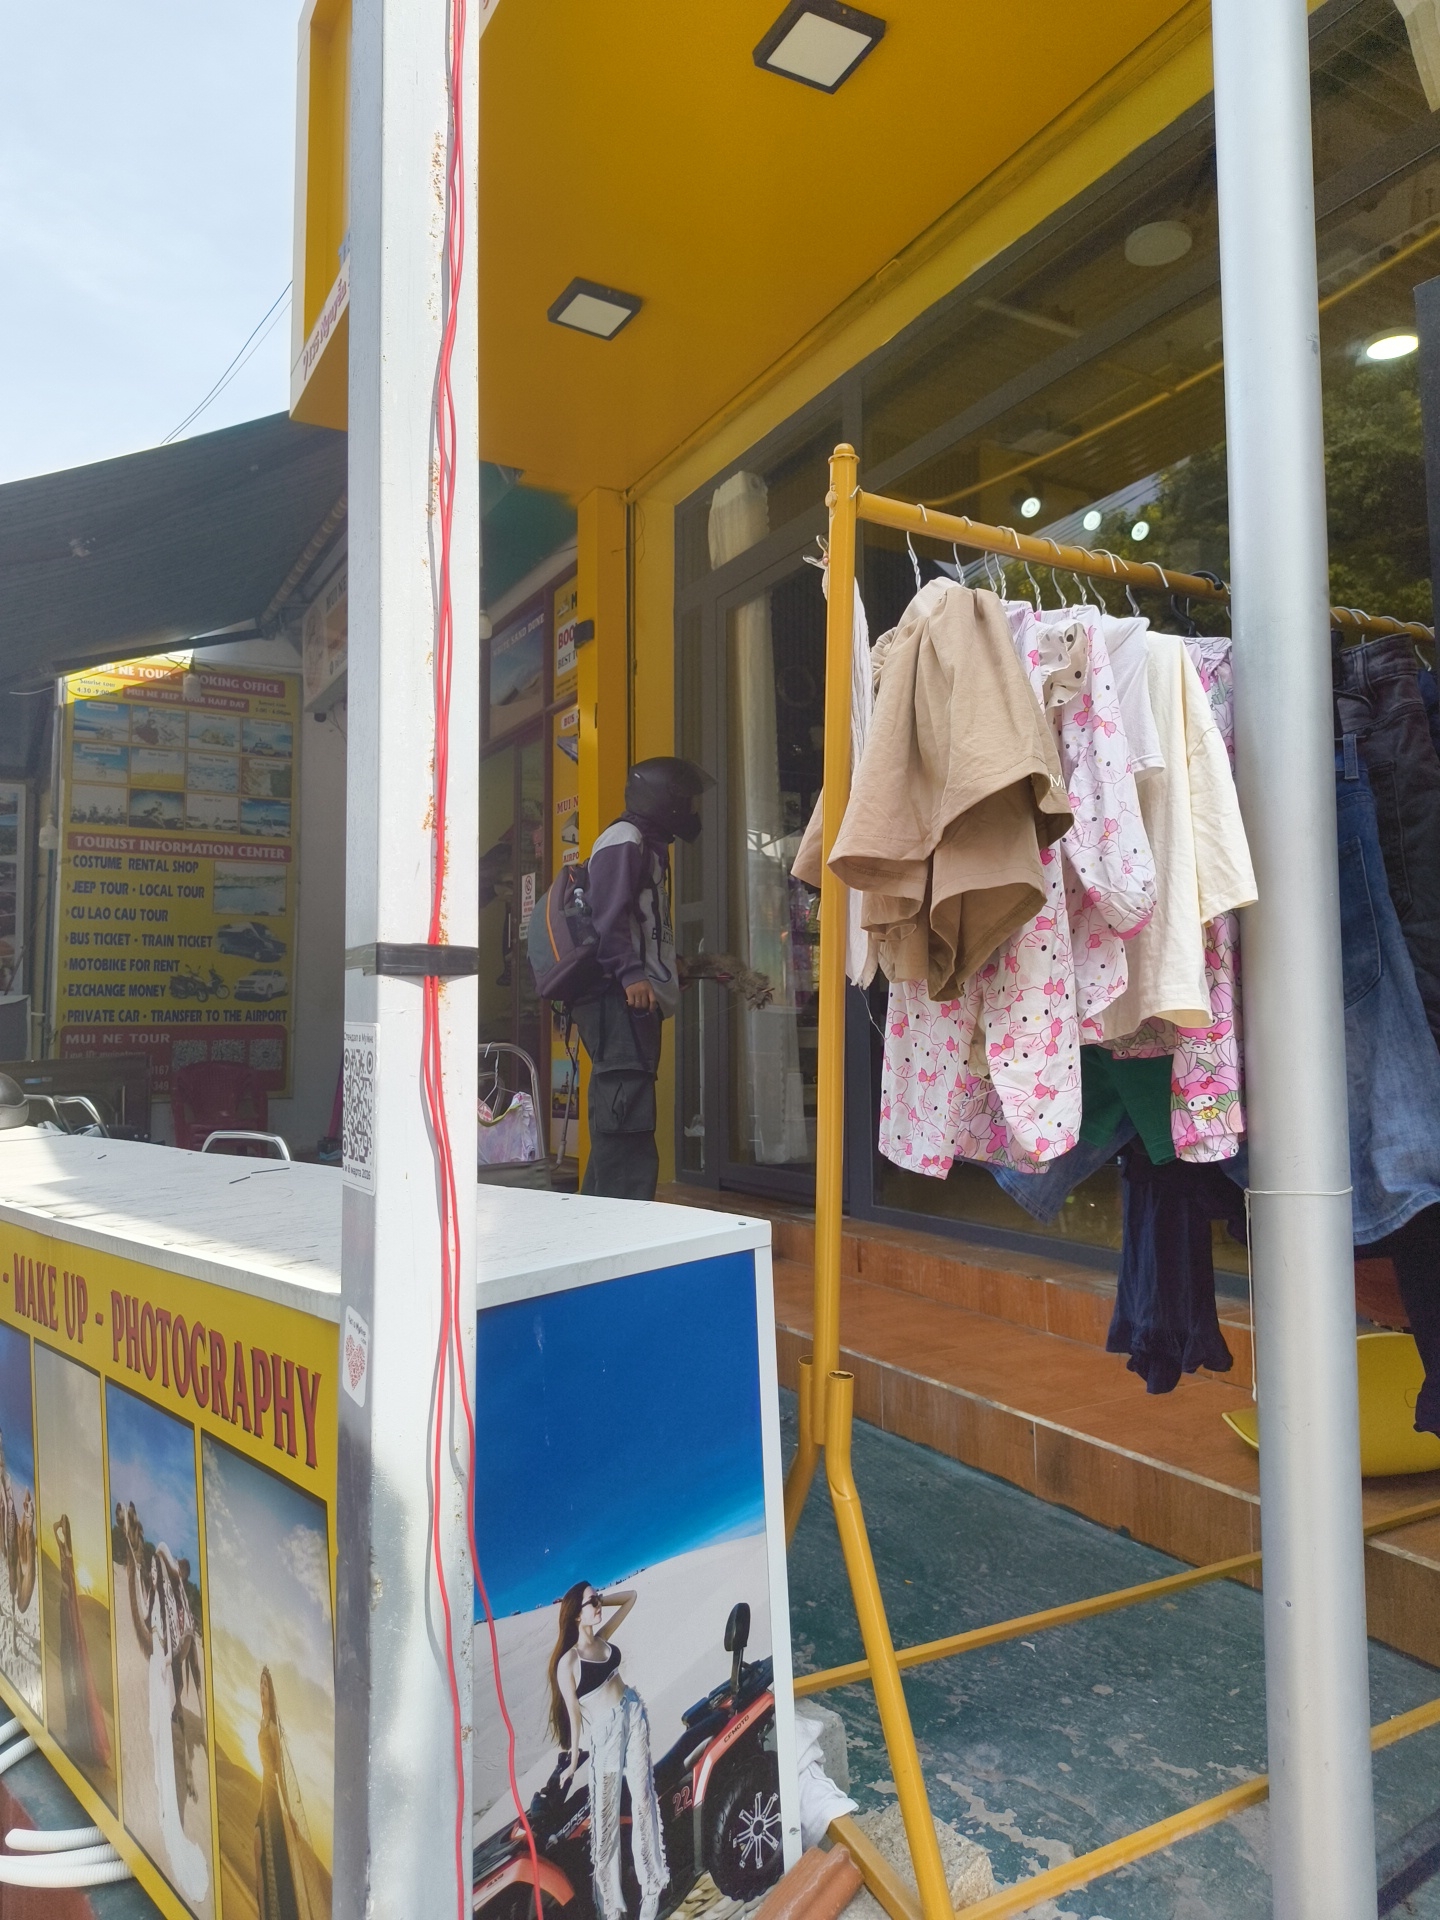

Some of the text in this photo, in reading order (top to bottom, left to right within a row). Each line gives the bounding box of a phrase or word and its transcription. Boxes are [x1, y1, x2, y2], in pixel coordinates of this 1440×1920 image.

[558, 624, 574, 650] BOO
[118, 666, 136, 676] NE
[138, 668, 172, 681] TOUR
[200, 674, 240, 689] OKING
[242, 680, 280, 694] OFFICE
[229, 700, 246, 709] DAY
[563, 714, 575, 727] BUS
[556, 799, 571, 814] MUI
[75, 836, 286, 859] TOURIST INFORMATION CENTER
[73, 855, 199, 873] COSTUME RENTAL SHOP
[563, 851, 579, 863] AIRPO
[71, 880, 205, 899] JEEP TOUR LOCAL TOUR
[71, 906, 169, 922] CU LAO CAU TOUR
[70, 932, 213, 948] BUS TICKET TRAIN TICKET
[69, 958, 181, 973] MOTOBIKE FOR RENT
[68, 984, 167, 997] EXCHANGE MONEY
[67, 1009, 288, 1022] PRIVATE CAR TRANSFER TO THE AIRPORT
[65, 1033, 170, 1045] MUI NE TOUR
[13, 1252, 59, 1332] MAKE
[63, 1270, 89, 1344] UP
[110, 1289, 322, 1470] PHOTOGRAPHY
[723, 1714, 750, 1745] CFMOTO
[671, 1785, 694, 1817] 22
